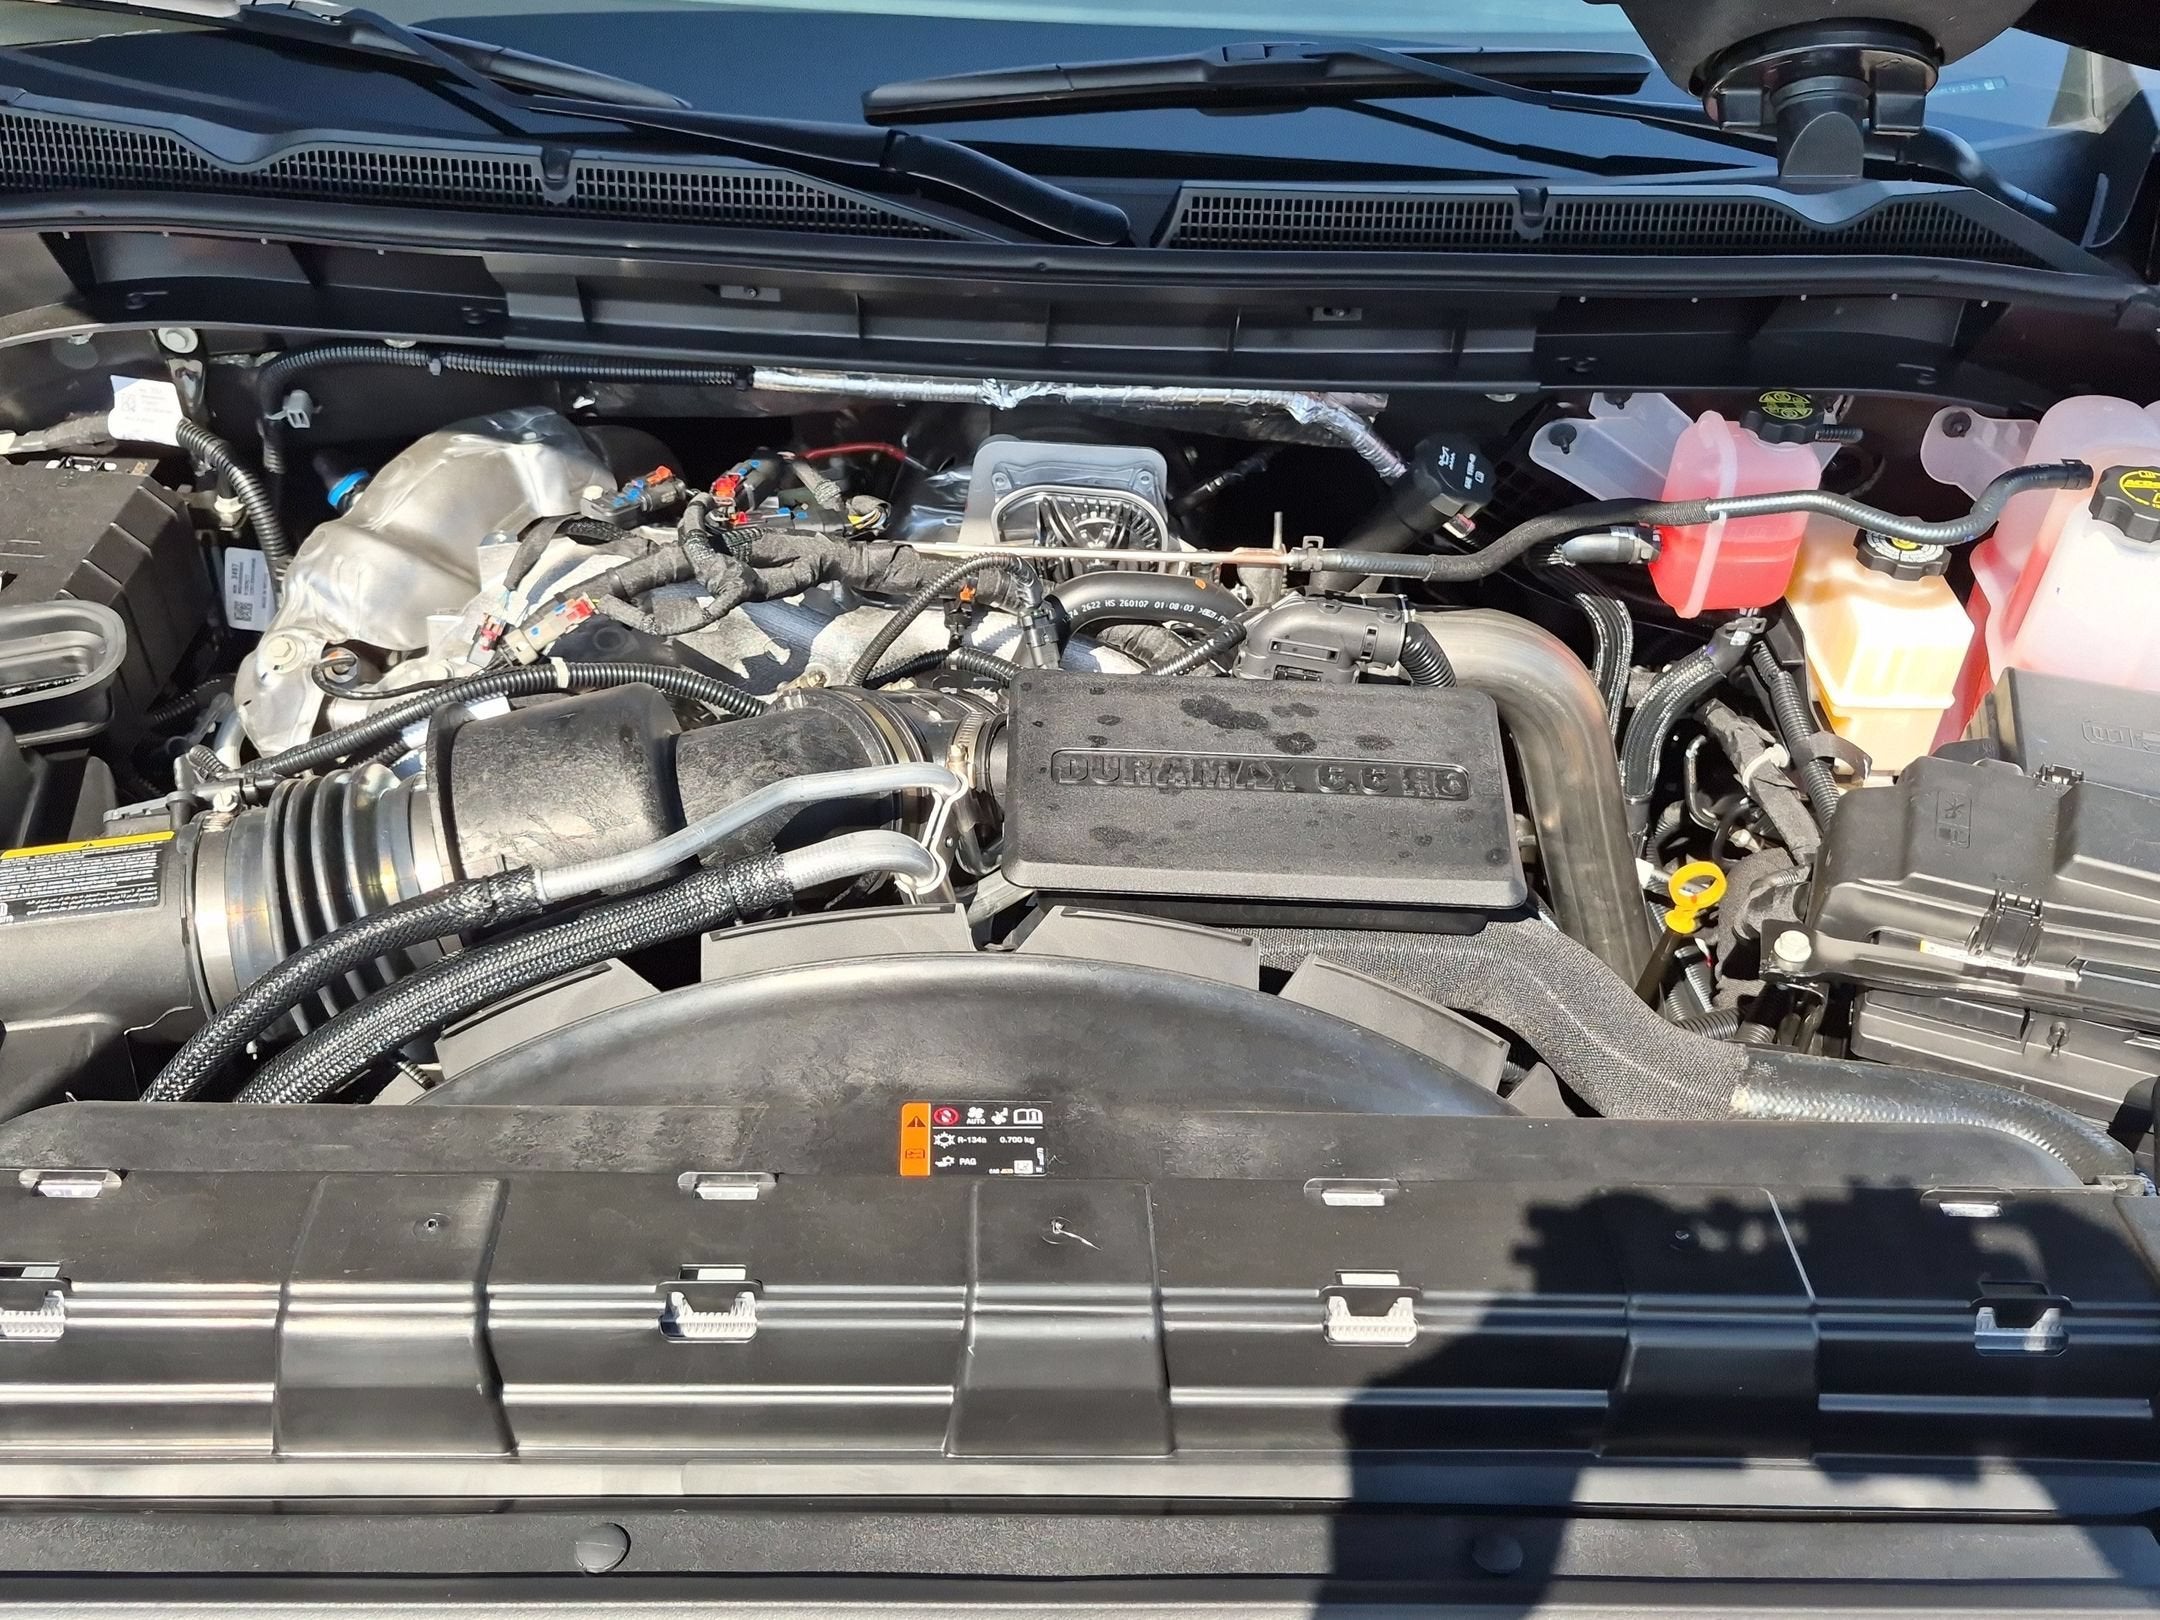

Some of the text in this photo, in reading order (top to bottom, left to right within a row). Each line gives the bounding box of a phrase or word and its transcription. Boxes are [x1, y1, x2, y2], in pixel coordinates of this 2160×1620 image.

[1081, 600, 1102, 613] 2622
[1119, 599, 1150, 608] 260107
[1054, 754, 1298, 791] DURAMAX
[1316, 764, 1390, 796] 6.6
[957, 1136, 1036, 1145] R-134a 0.700 kg
[959, 1157, 977, 1166] PAG
